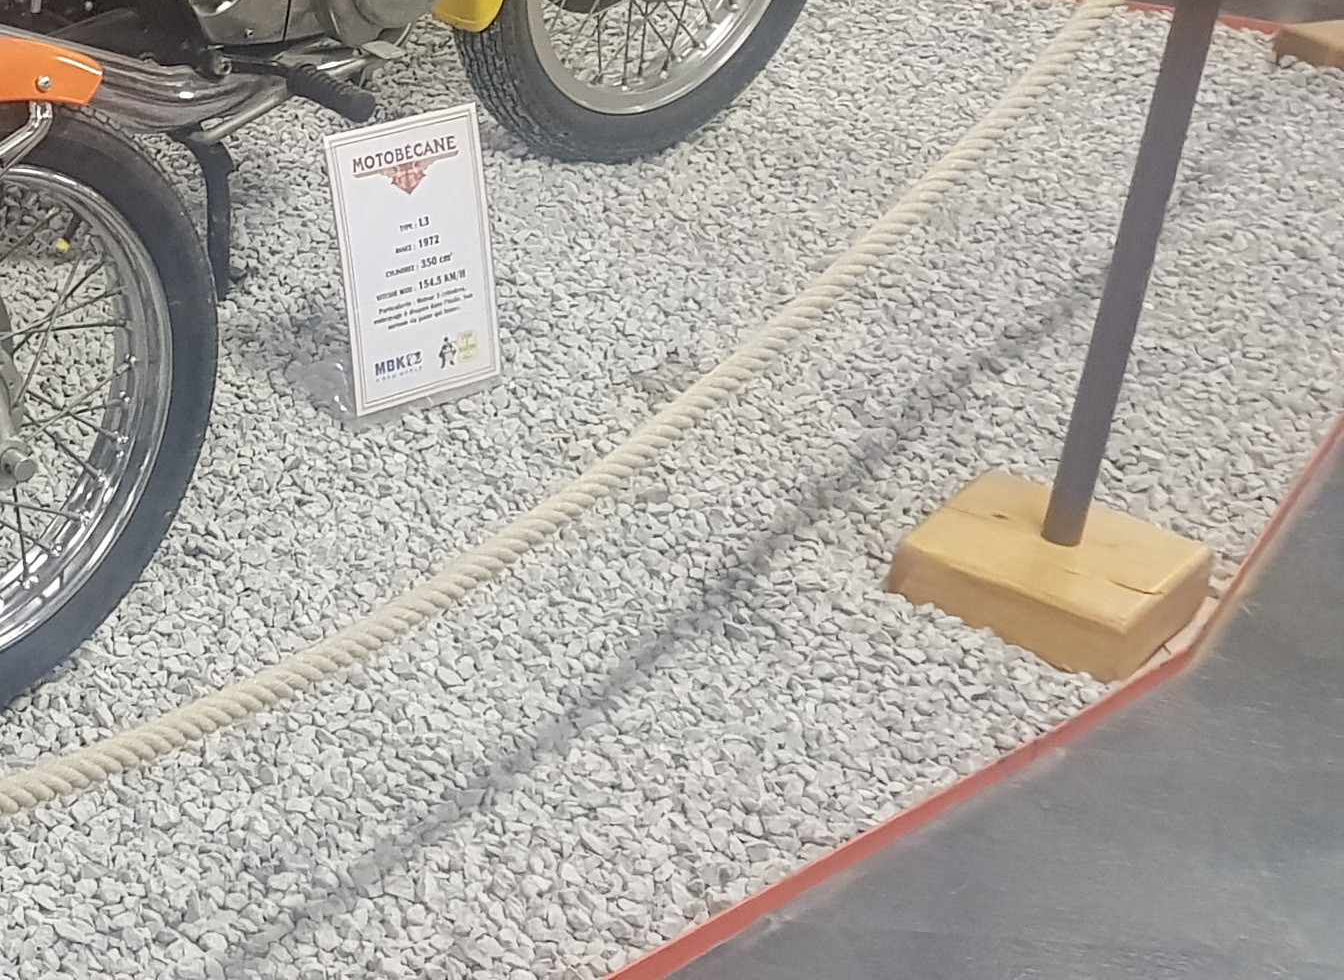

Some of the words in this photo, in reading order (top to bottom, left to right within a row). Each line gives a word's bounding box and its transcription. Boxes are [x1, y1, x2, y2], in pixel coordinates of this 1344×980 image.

[352, 135, 457, 173] MOTOBÉCANE
[419, 216, 430, 227] L3
[419, 235, 440, 248] 1972
[421, 256, 437, 269] 350
[444, 269, 466, 282] KM/H
